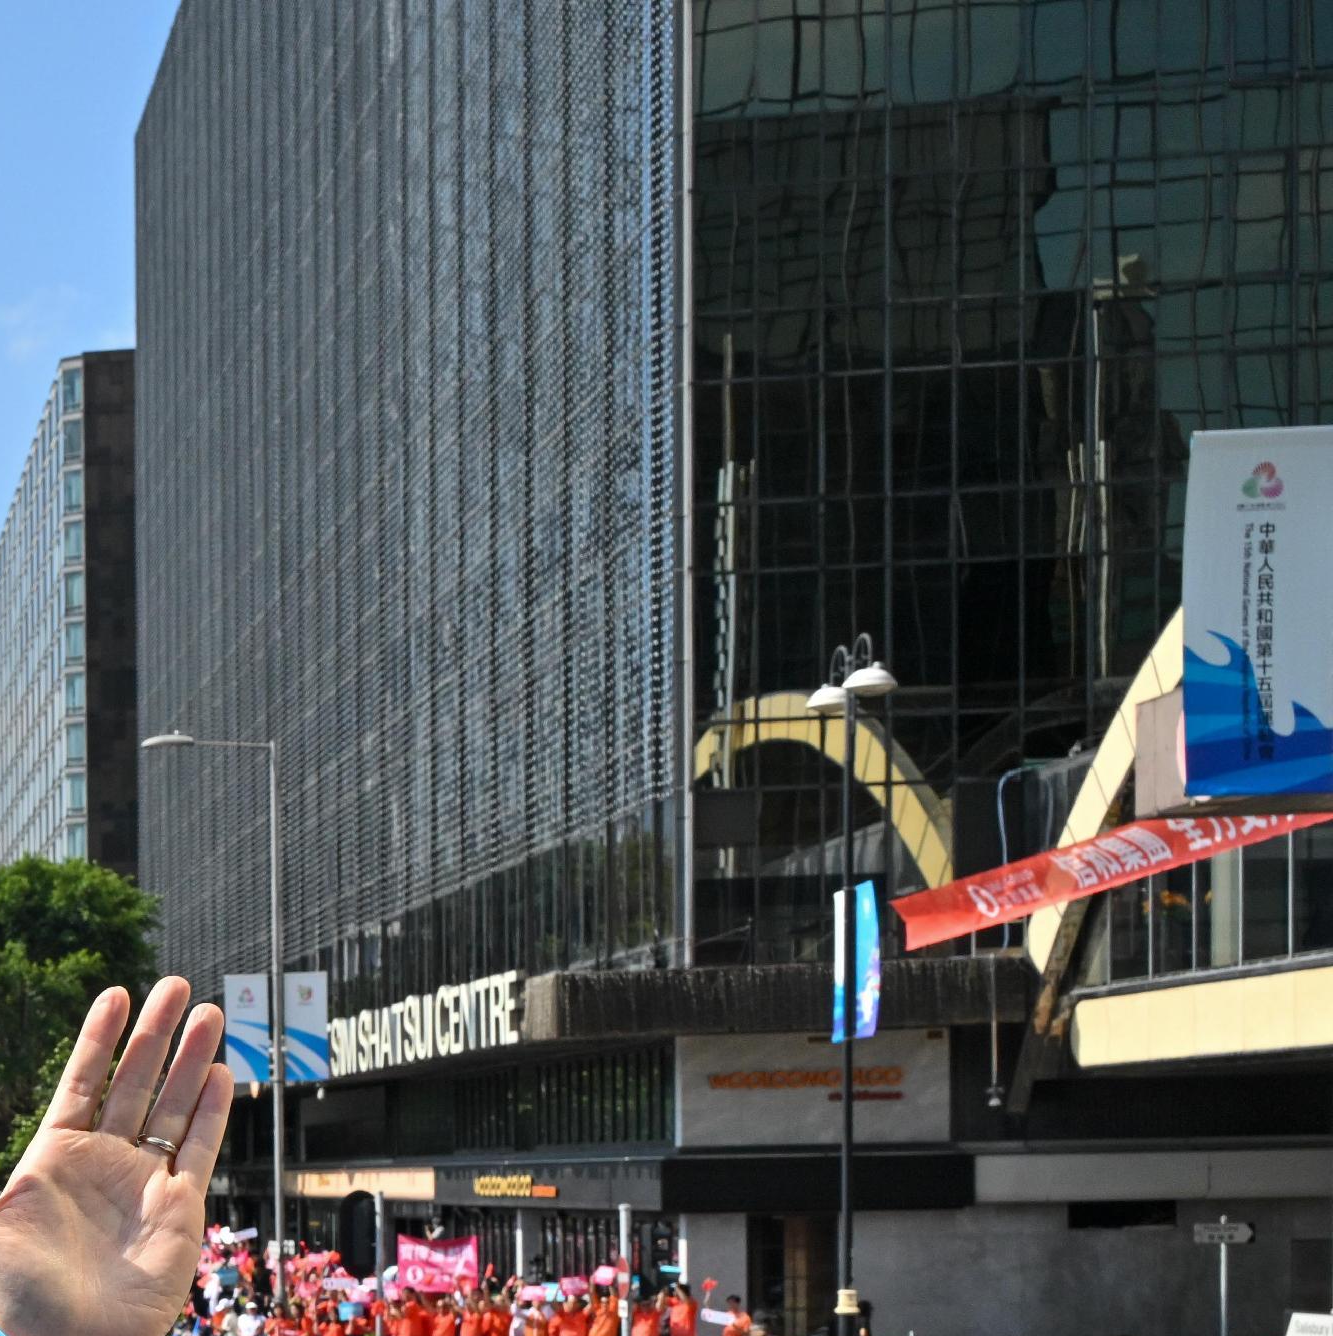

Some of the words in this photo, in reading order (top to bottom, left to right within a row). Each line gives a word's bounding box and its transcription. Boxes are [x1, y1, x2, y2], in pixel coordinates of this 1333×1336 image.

[358, 1006, 393, 1073] SHA
[391, 993, 433, 1065] TSUI
[435, 969, 519, 1057] CENTRE
